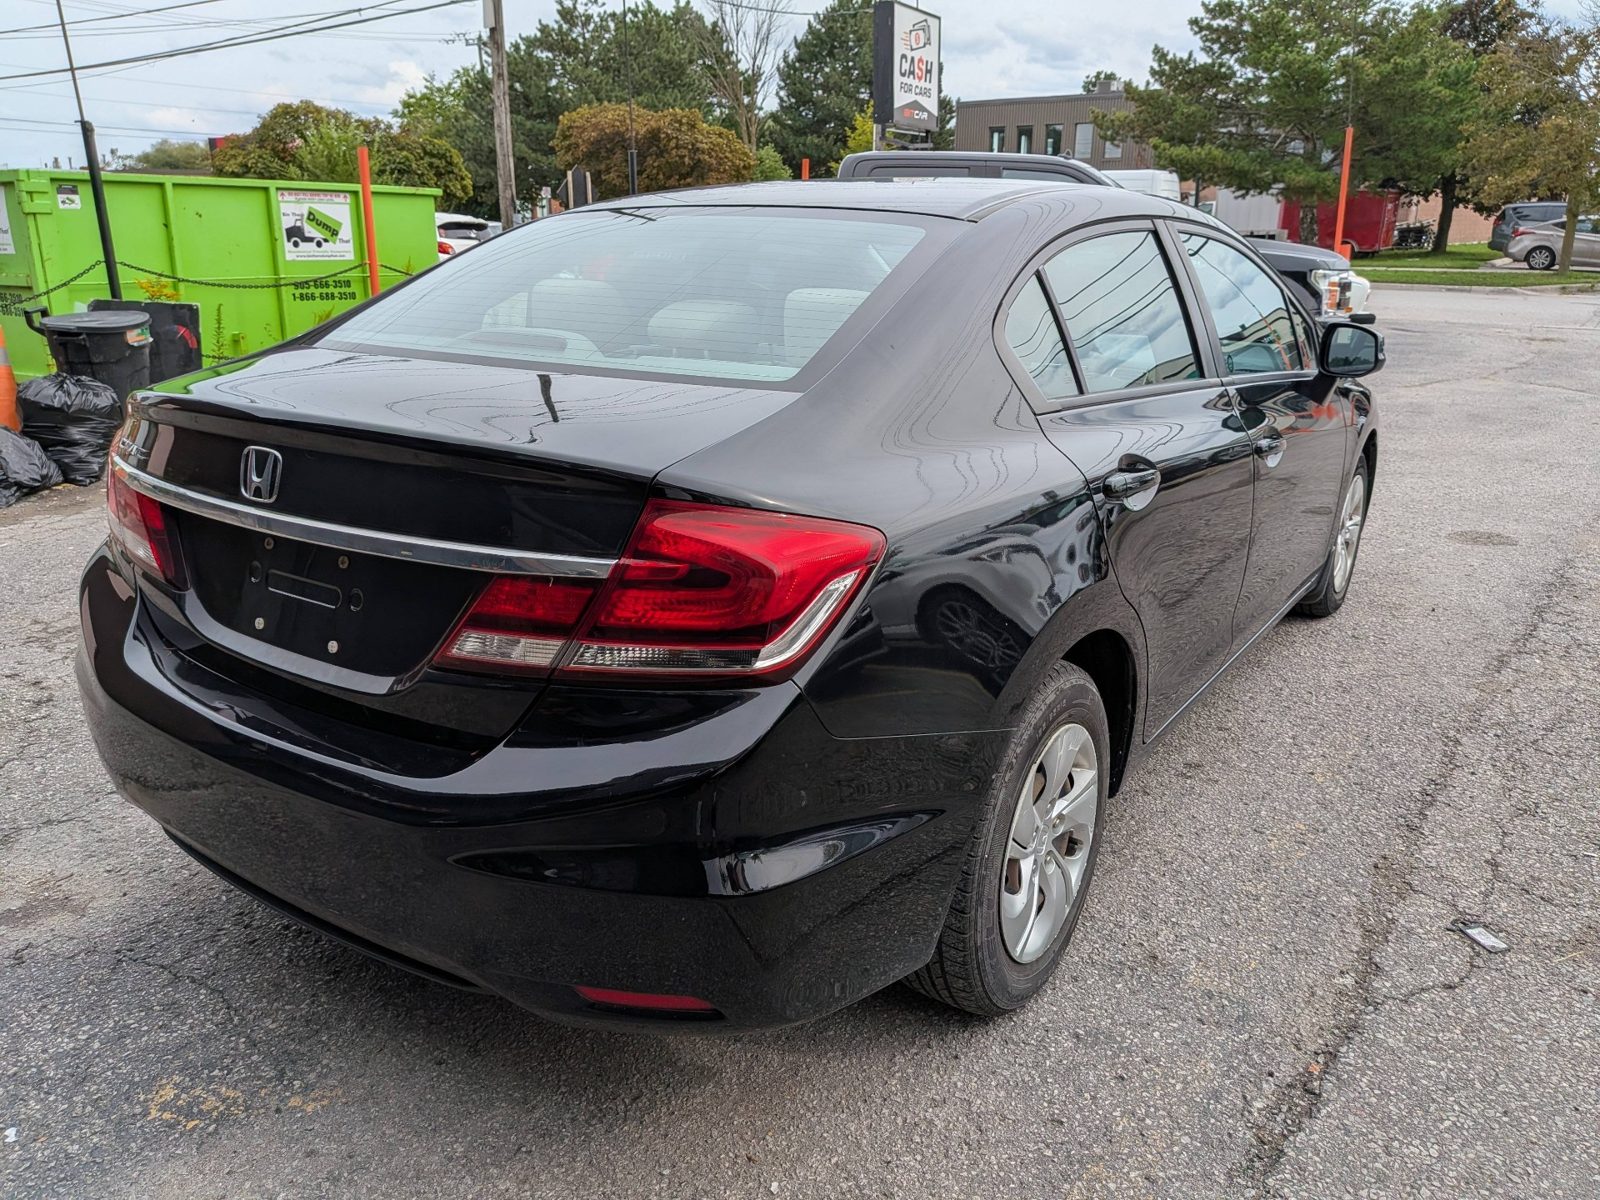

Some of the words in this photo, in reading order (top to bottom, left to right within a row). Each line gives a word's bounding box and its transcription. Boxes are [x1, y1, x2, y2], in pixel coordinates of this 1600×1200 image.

[900, 82, 913, 94] FOR
[914, 85, 932, 98] CARS
[306, 211, 339, 237] Dump
[292, 291, 356, 302] 1-866-688-3510
